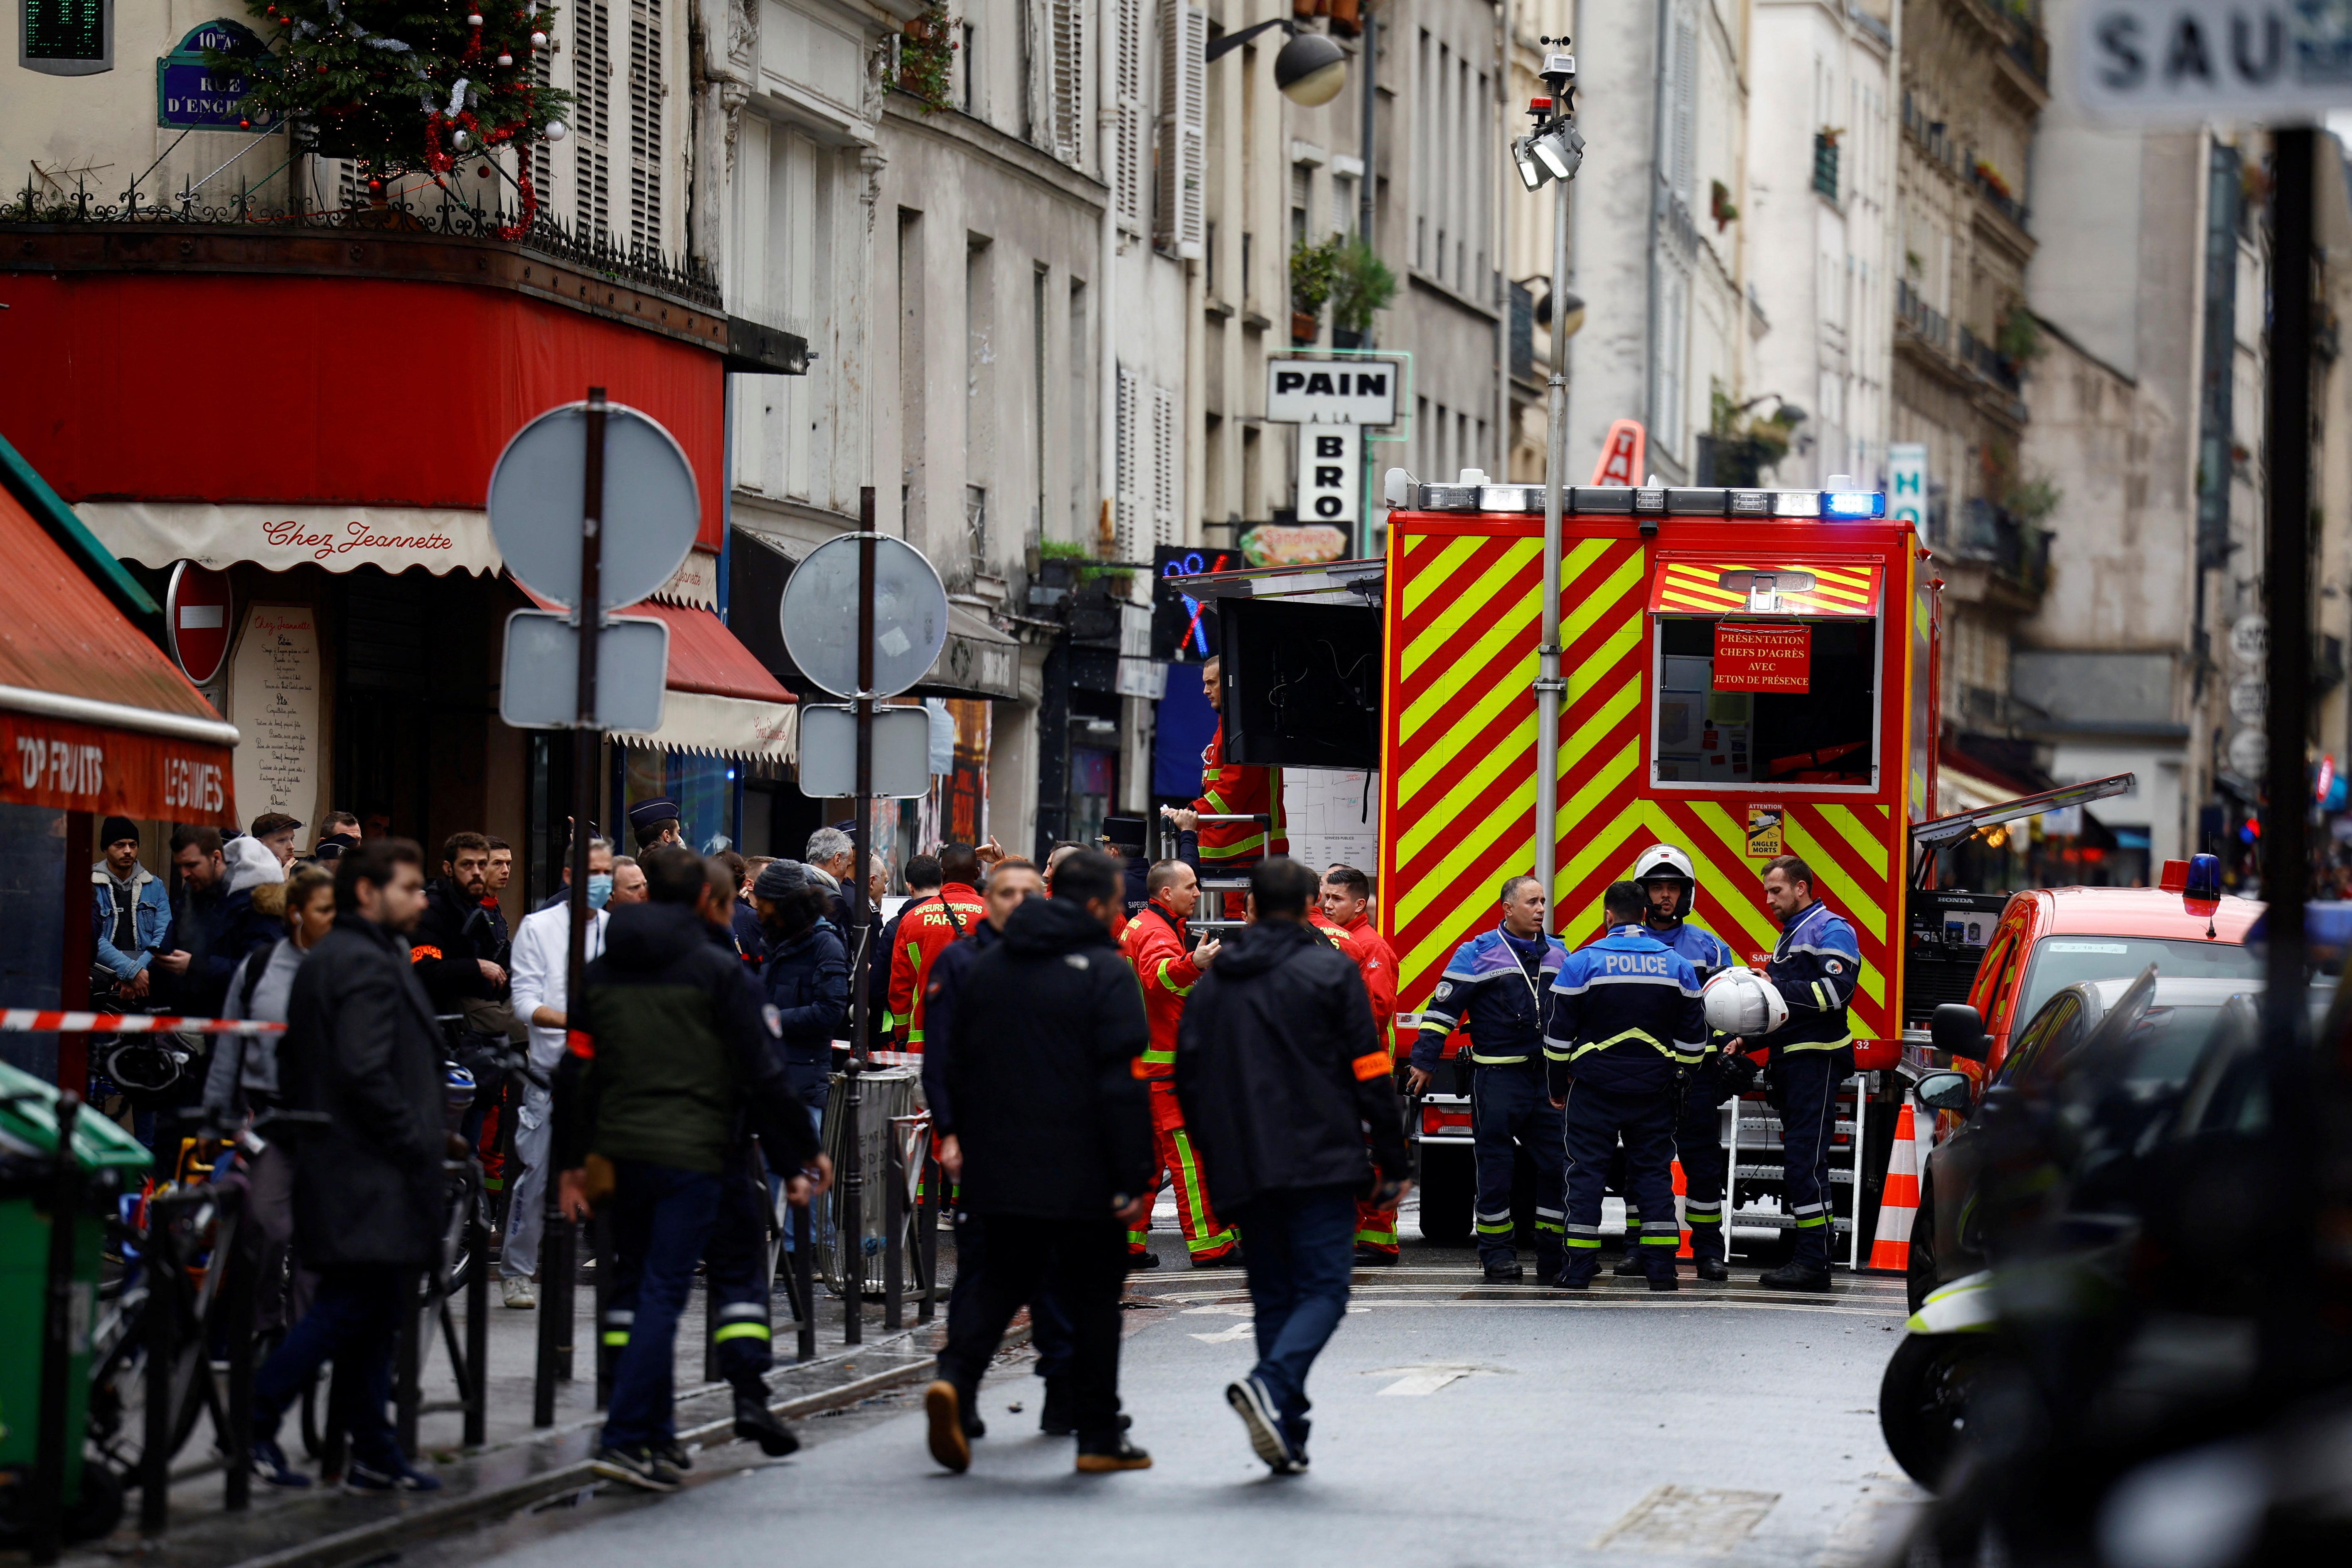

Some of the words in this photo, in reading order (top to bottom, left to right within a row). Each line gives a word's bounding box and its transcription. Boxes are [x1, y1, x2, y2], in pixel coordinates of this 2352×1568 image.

[200, 77, 240, 92] RUE
[1276, 372, 1387, 397] PAIN
[1333, 413, 1351, 424] LA
[263, 521, 336, 559] Chez
[337, 521, 453, 553] Jeannette
[1264, 529, 1336, 544] Sandwich
[254, 615, 275, 635] Chez
[277, 616, 311, 630] Jeannette
[1721, 633, 1805, 645] PRÉSENTATION
[1720, 648, 1755, 657] CHEFS
[1758, 648, 1805, 658] D'AGRÈS
[1748, 662, 1776, 671] AVEC
[1714, 675, 1744, 684] JETON
[1747, 676, 1759, 684] DE
[1762, 675, 1808, 686] PRÉSENCE
[49, 740, 103, 795] FRUITS
[914, 903, 944, 916] SAPEURS
[923, 913, 967, 926] PARS
[1605, 955, 1668, 975] POLICE
[1856, 1041, 1870, 1050] 32
